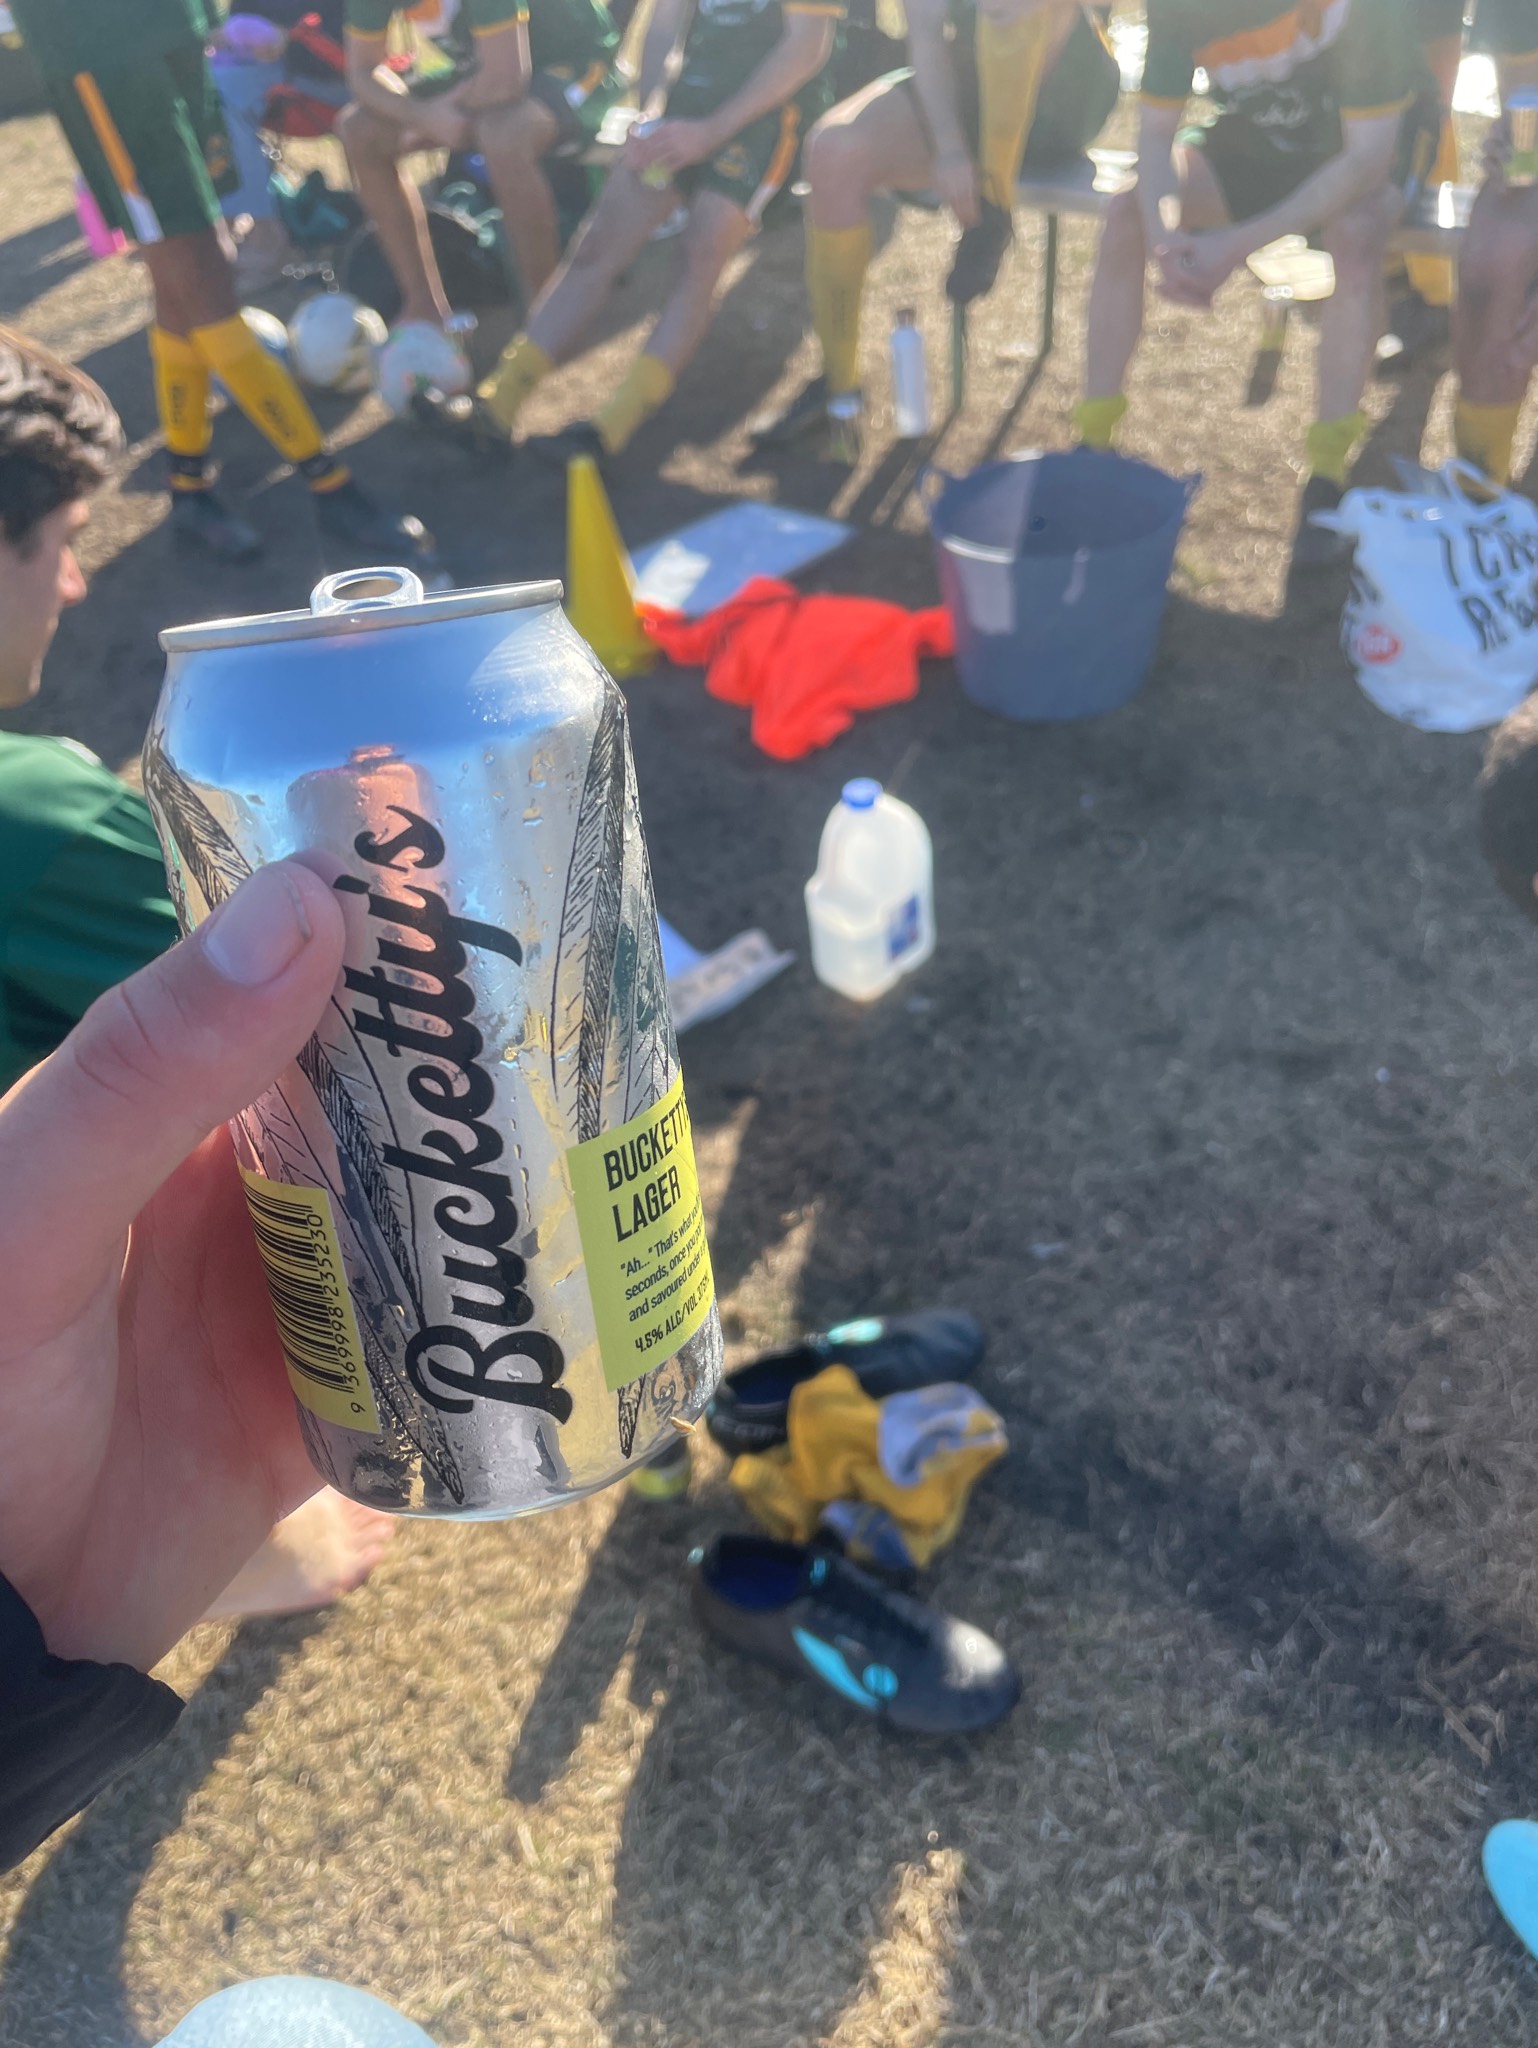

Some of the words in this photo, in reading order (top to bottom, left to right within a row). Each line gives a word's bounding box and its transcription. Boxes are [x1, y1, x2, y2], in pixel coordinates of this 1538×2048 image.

[333, 805, 573, 1426] Bucketty's
[612, 1165, 682, 1243] LAGER
[307, 1214, 339, 1297] 235230
[654, 1230, 679, 1257] That's
[678, 1214, 693, 1237] what
[625, 1264, 669, 1300] seconds,
[669, 1246, 687, 1271] once
[629, 1298, 649, 1322] and
[651, 1267, 687, 1309] savoured
[329, 1307, 360, 1388] 369998
[635, 1323, 664, 1353] 4.5%
[665, 1293, 698, 1336] ALC/VOL
[350, 1402, 365, 1413] 9
